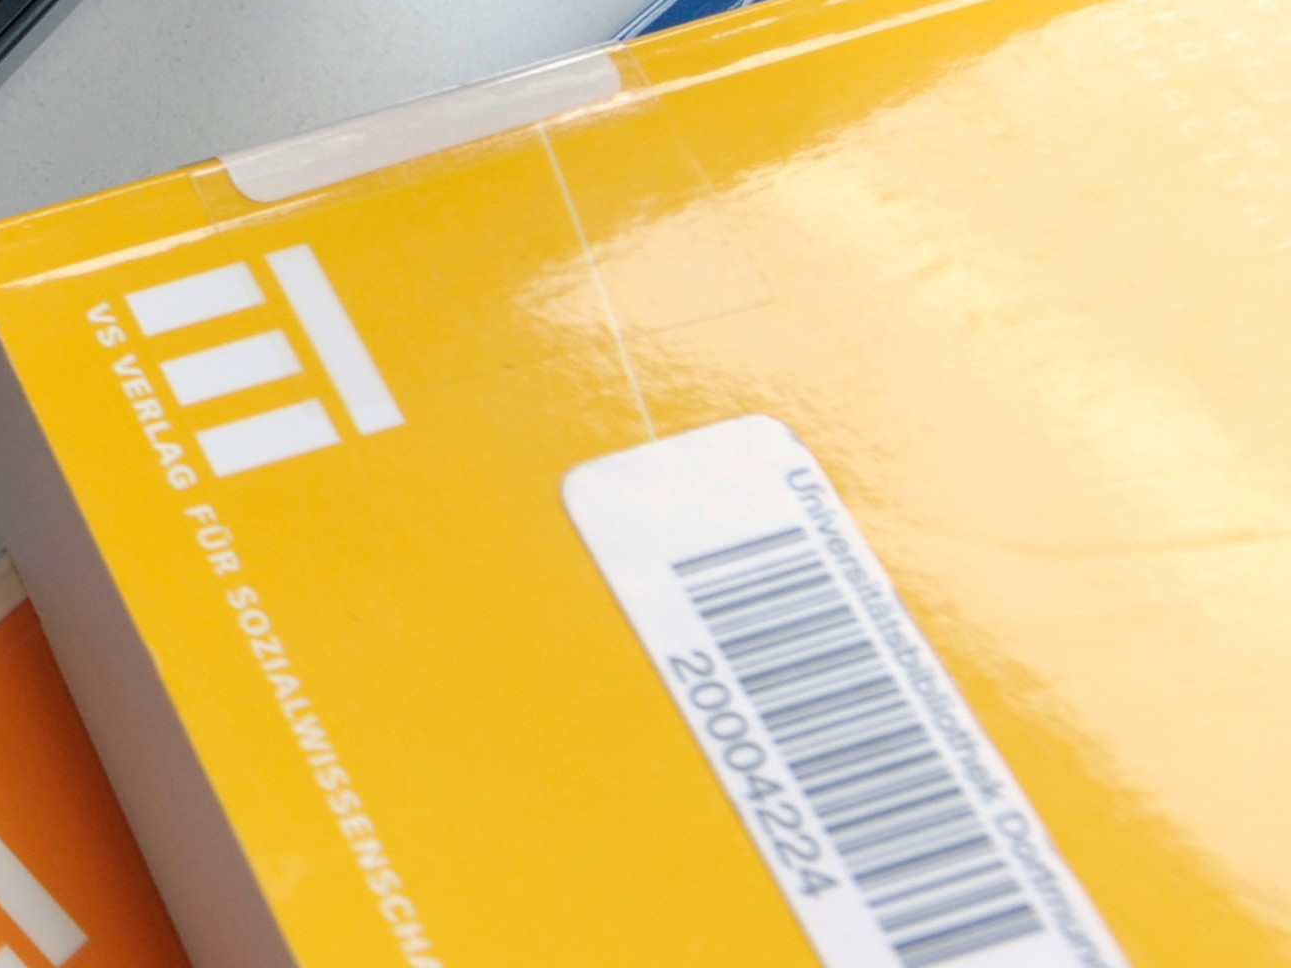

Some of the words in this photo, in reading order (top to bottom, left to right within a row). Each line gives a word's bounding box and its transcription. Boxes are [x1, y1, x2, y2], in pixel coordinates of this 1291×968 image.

[85, 300, 127, 348] VS
[111, 353, 198, 490] VERLAG
[183, 503, 241, 575] FÜR
[785, 467, 1004, 804] Universitätsbibliothek
[667, 649, 840, 900] 20004224
